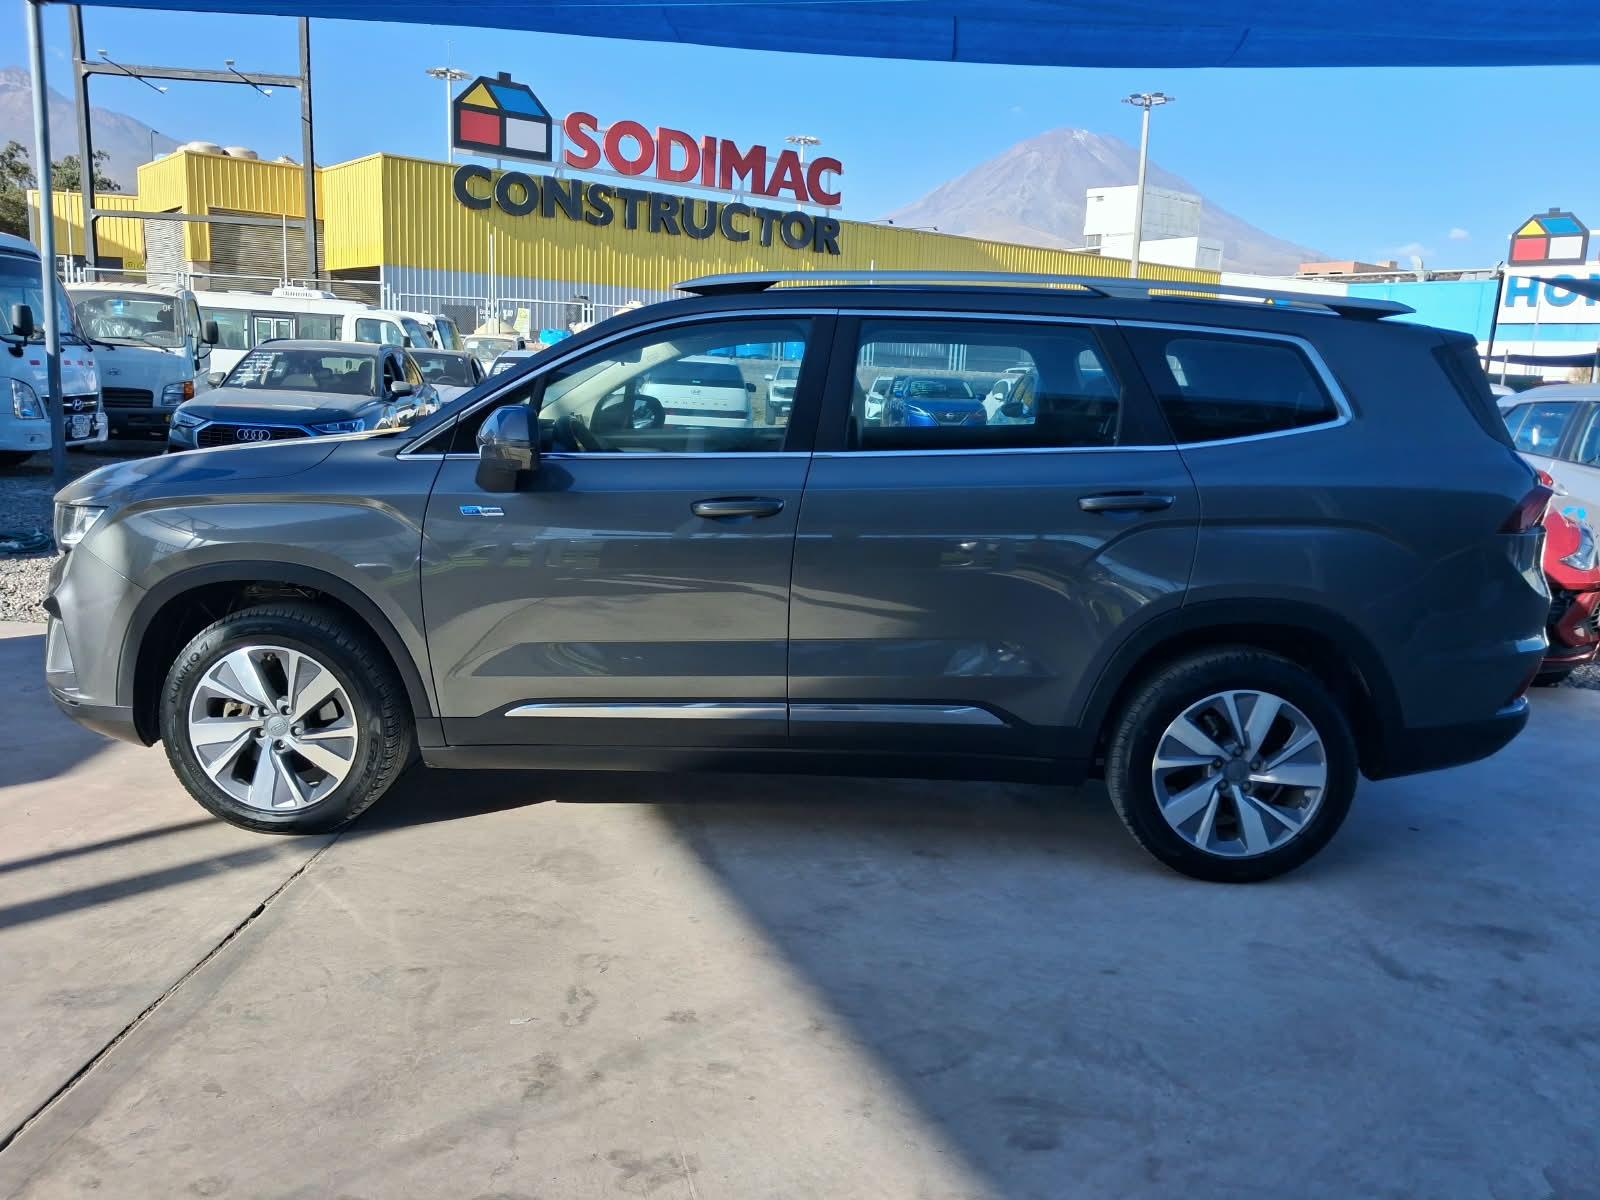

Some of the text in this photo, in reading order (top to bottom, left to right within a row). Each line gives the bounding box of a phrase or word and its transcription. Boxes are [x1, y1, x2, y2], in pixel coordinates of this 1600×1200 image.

[563, 111, 843, 206] SODIMAC
[453, 164, 841, 256] CONSTRUCTOR
[1505, 274, 1600, 307] HO
